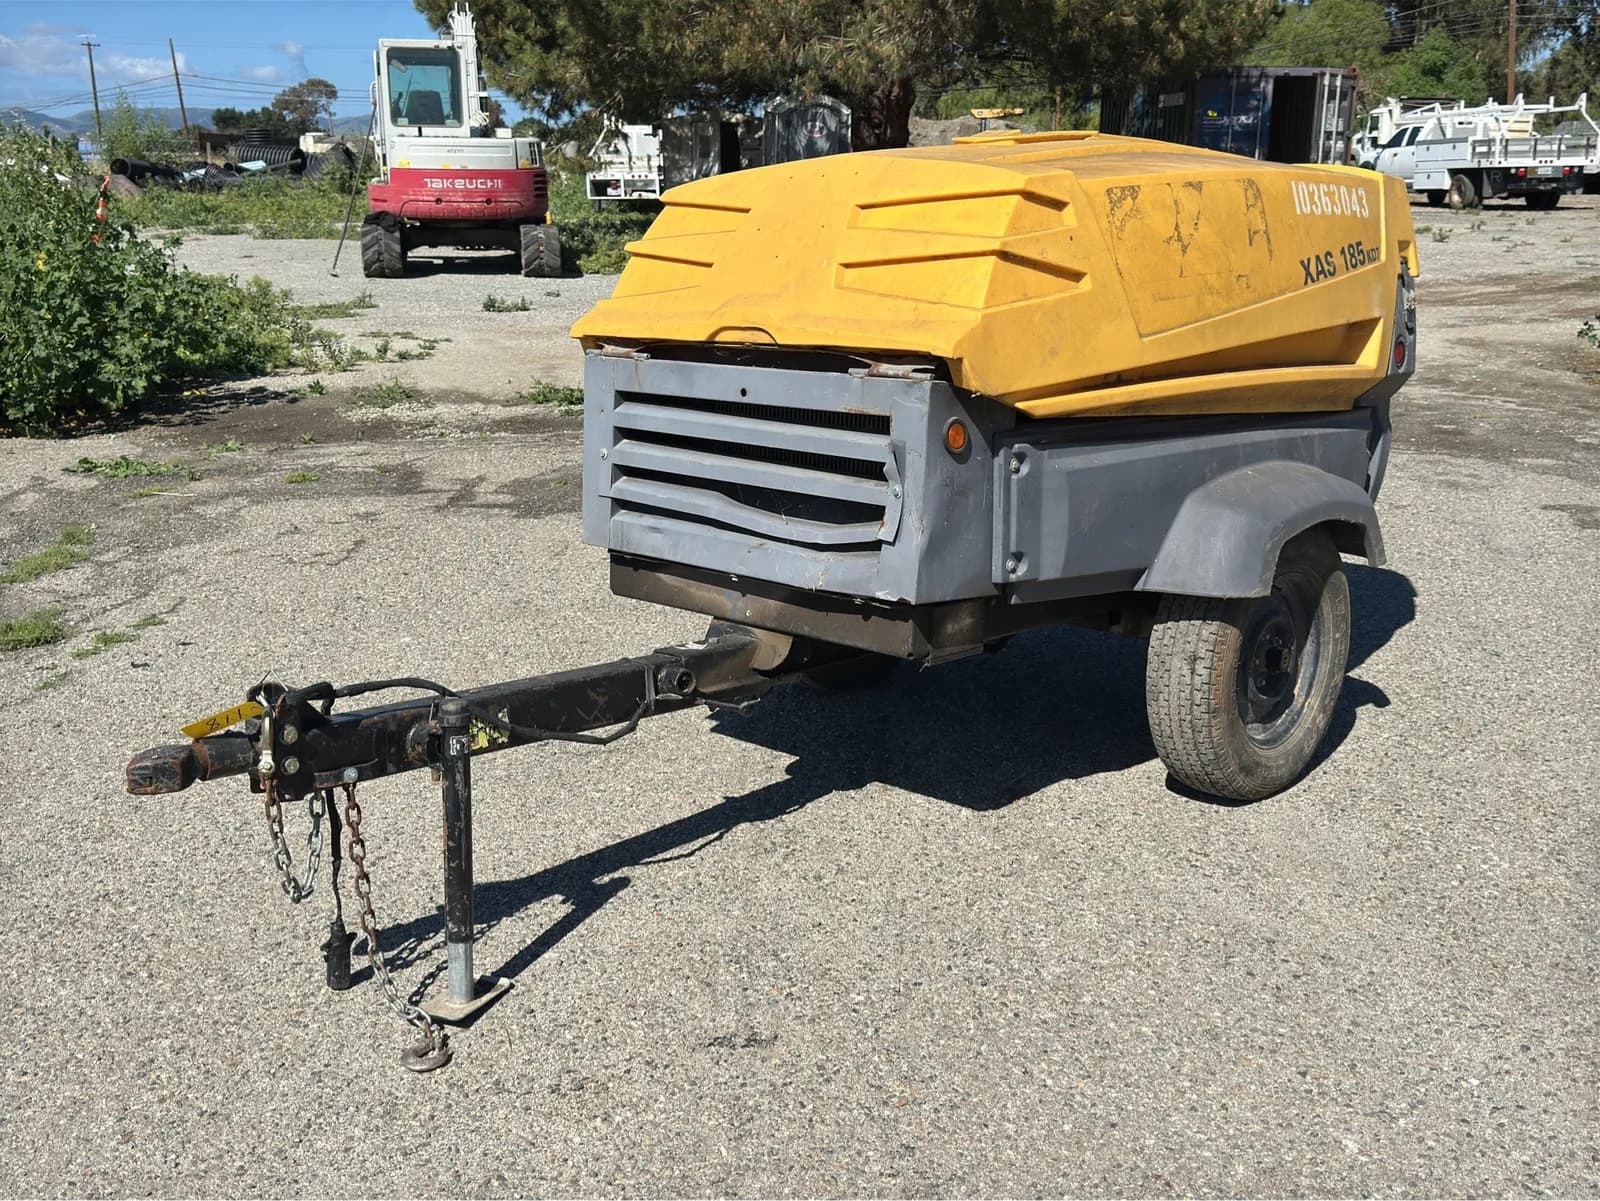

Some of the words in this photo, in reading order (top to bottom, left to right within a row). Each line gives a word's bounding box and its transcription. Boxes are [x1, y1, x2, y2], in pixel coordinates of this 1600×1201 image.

[423, 178, 502, 189] TAKEUCHI
[1291, 180, 1369, 218] 10363043
[1299, 250, 1337, 286] XAS
[1340, 240, 1366, 272] 185
